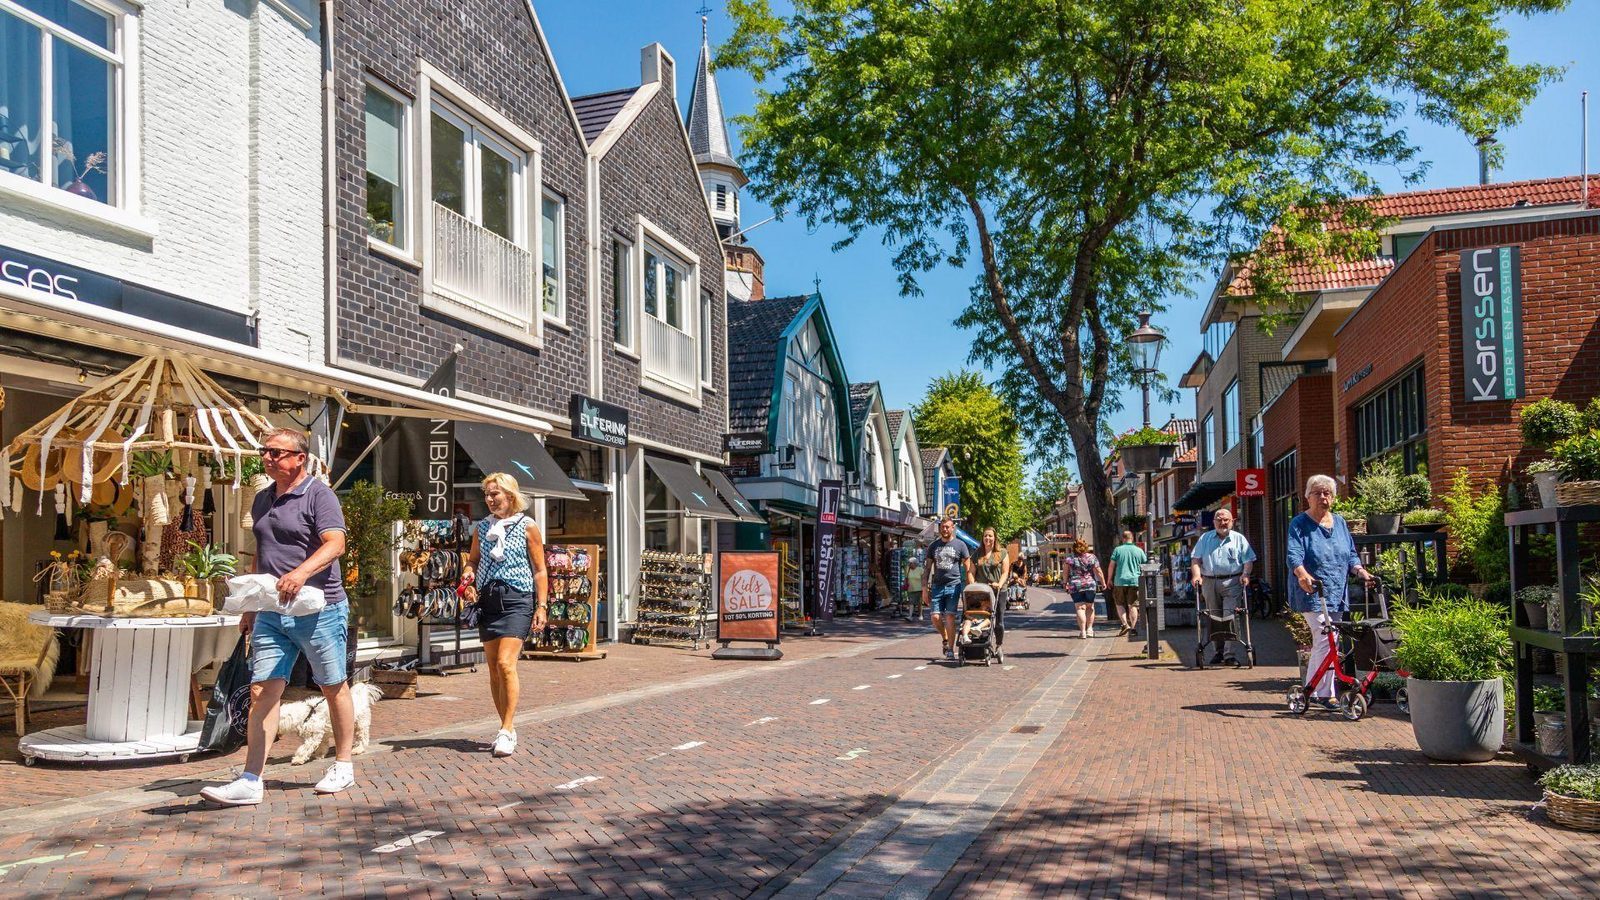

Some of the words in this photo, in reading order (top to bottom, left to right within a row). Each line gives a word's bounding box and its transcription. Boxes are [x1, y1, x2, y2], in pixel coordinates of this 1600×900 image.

[1502, 247, 1512, 313] FASHION
[1472, 248, 1498, 401] Karssen
[1504, 320, 1513, 340] EN
[1505, 347, 1515, 397] SPORT
[580, 412, 627, 437] ELFERINK
[428, 441, 449, 513] IBISAS
[1244, 473, 1259, 490] S
[729, 594, 766, 610] SALE
[747, 611, 773, 619] KORTING
